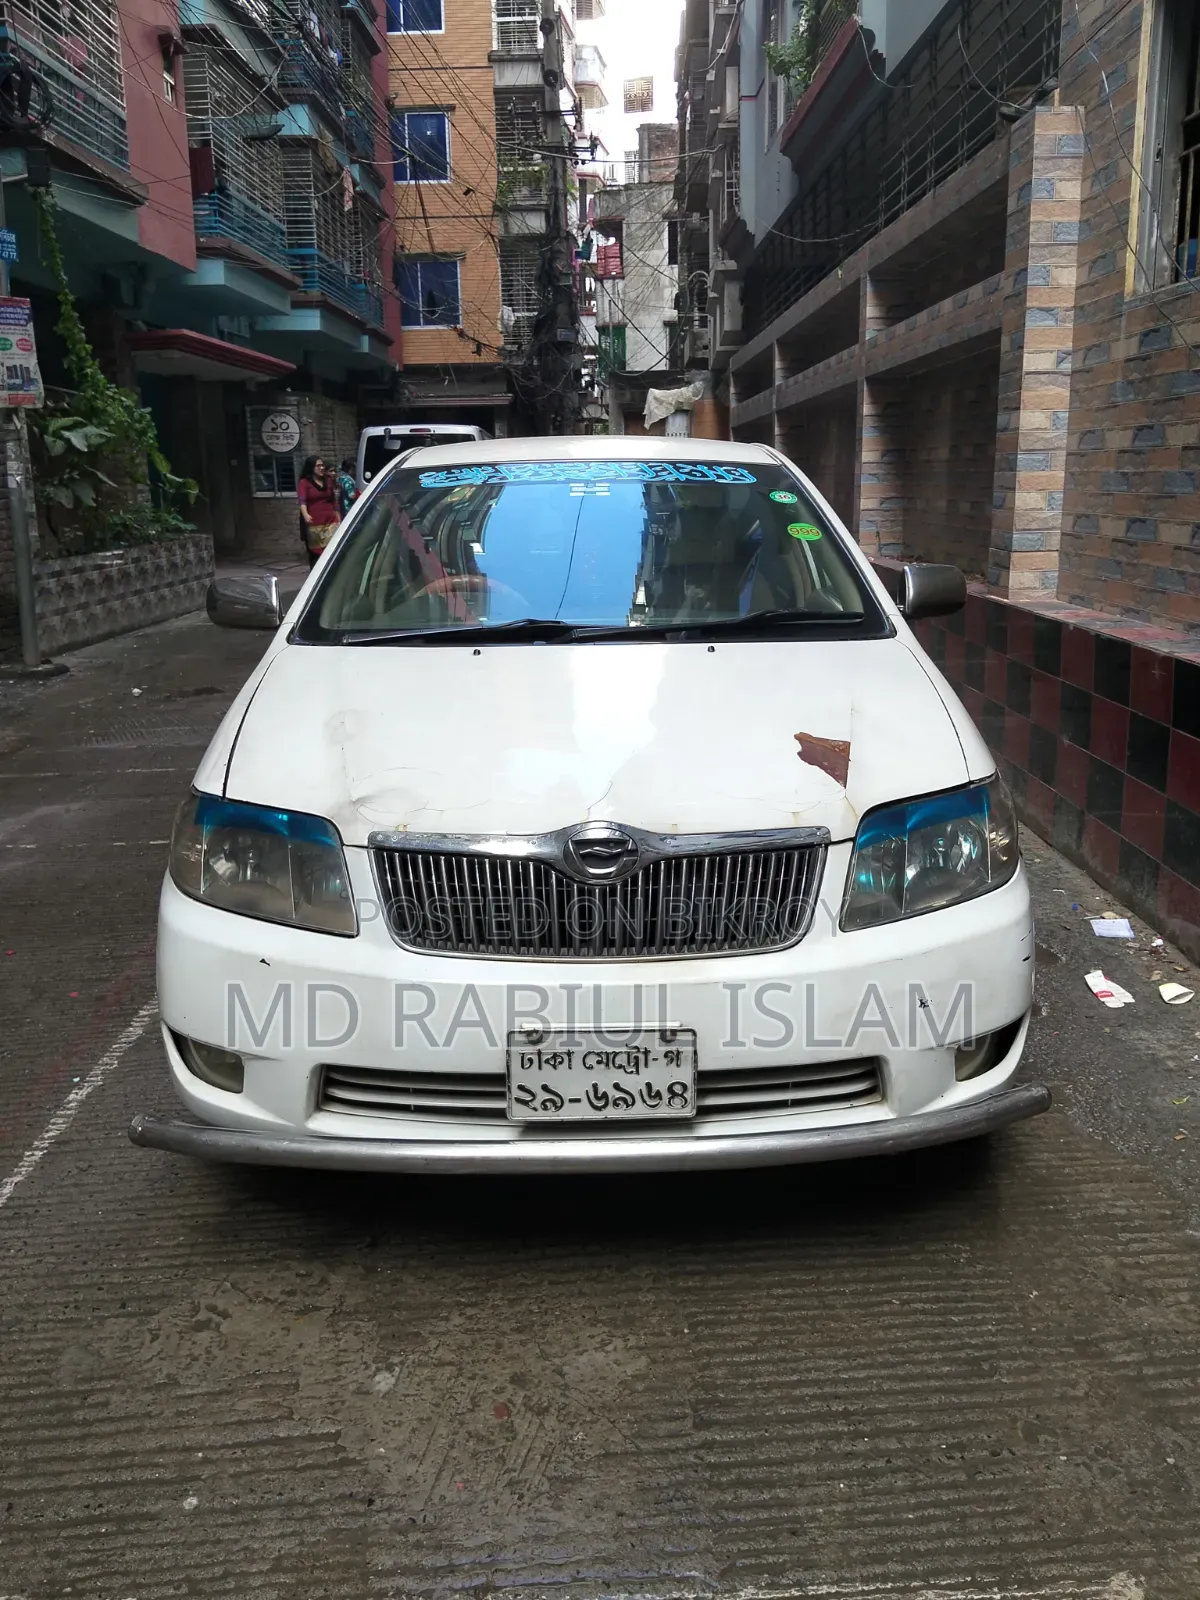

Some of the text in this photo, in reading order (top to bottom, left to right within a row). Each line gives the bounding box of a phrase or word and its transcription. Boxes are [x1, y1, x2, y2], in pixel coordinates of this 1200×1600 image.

[270, 418, 290, 431] ১০
[789, 527, 820, 537] 999
[518, 1048, 575, 1070] ঢাকা
[514, 1080, 690, 1112] ২৯-৬৯৬৪
